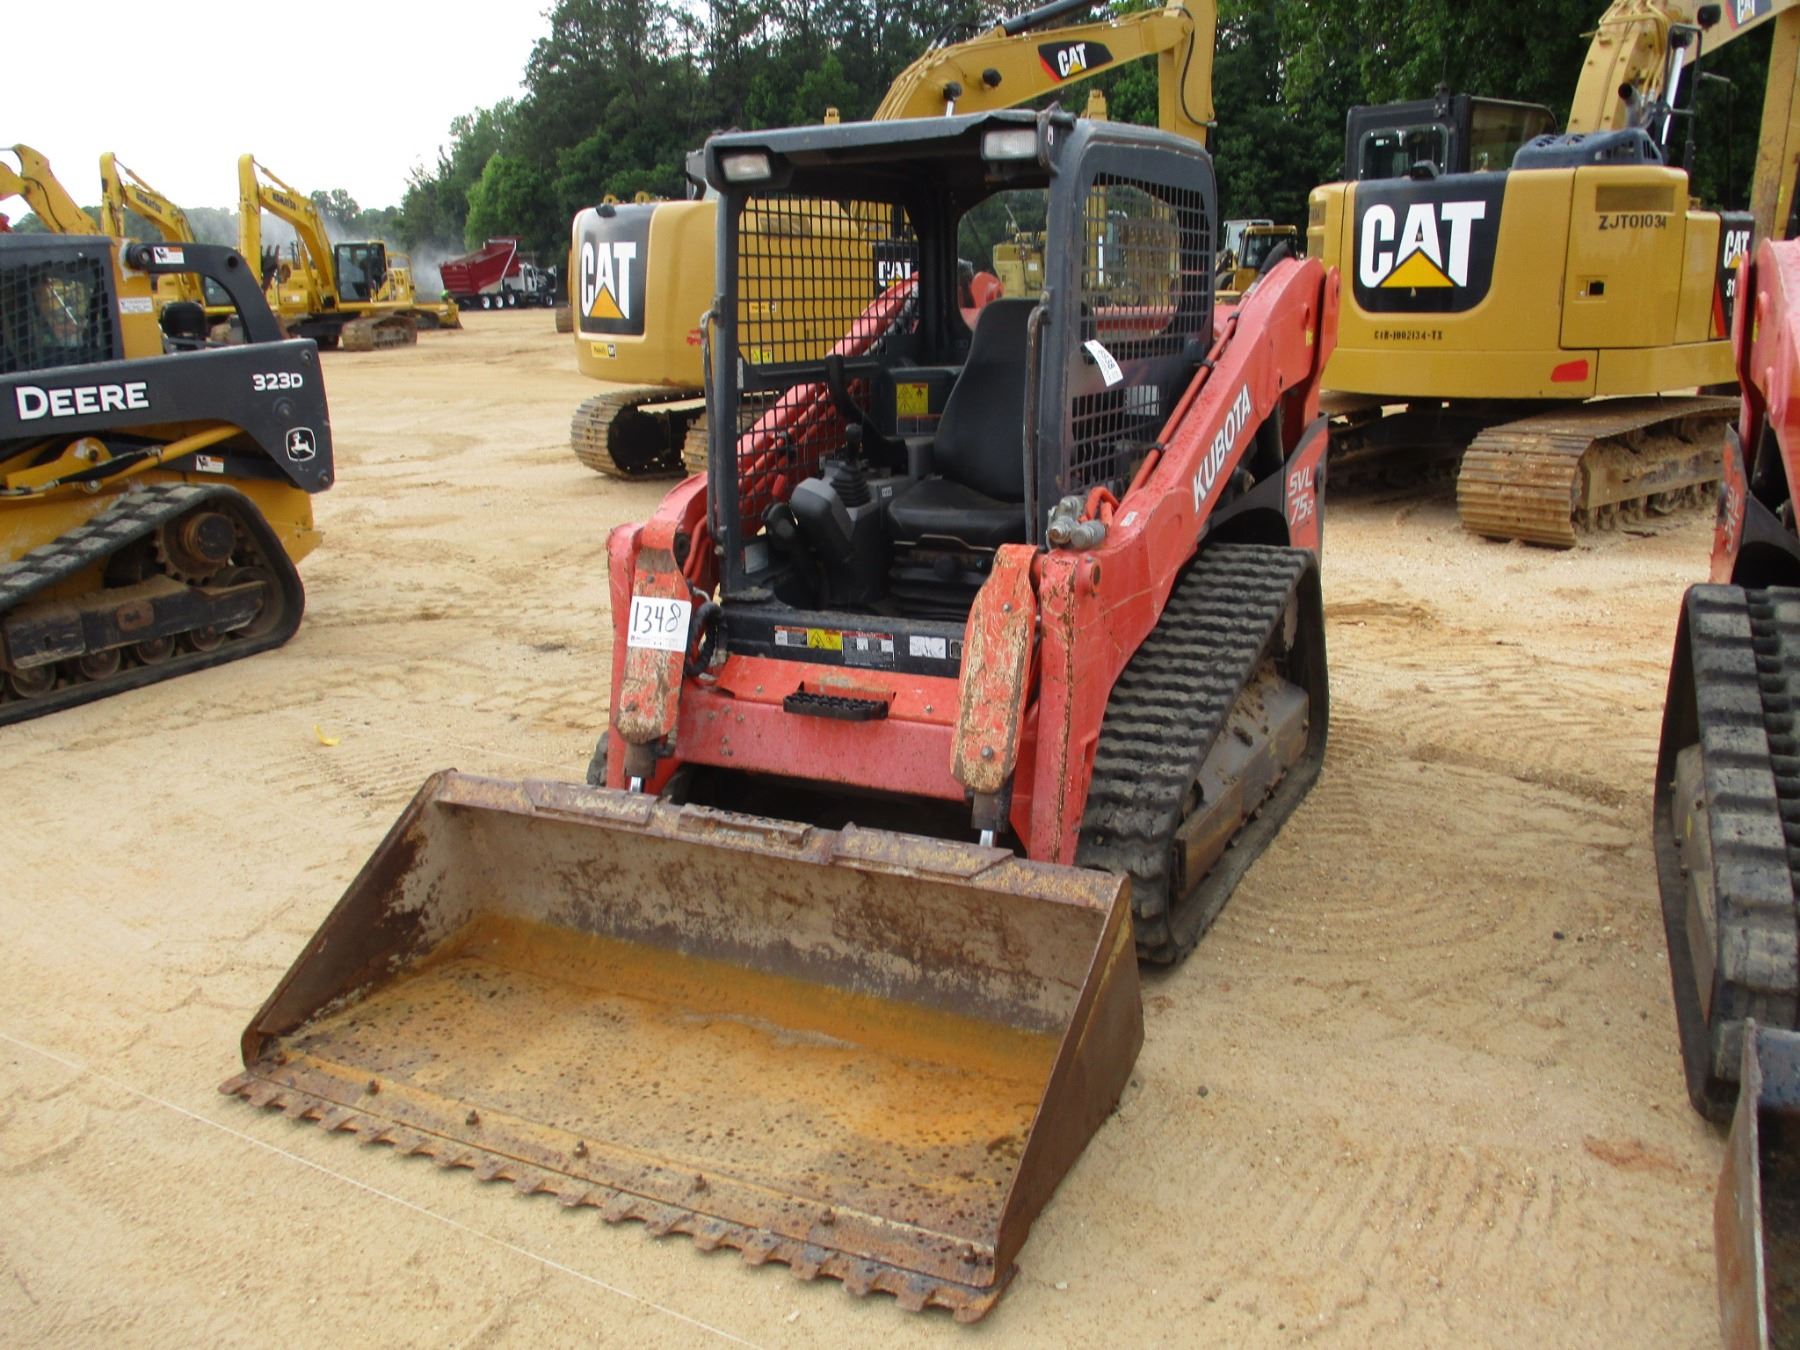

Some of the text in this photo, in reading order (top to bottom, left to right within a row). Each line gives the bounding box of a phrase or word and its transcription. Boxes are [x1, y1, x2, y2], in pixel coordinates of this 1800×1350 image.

[1057, 42, 1087, 78] CAT
[1598, 214, 1667, 231] ZJT01034
[1359, 200, 1486, 289] CAT
[1723, 230, 1750, 270] CAT
[581, 241, 637, 320] CAT
[878, 260, 912, 288] CAT
[252, 372, 304, 392] 323D
[16, 381, 150, 421] DEERE
[1193, 383, 1252, 513] KUBOTA
[1288, 466, 1313, 498] SVL
[633, 601, 682, 635] 1348
